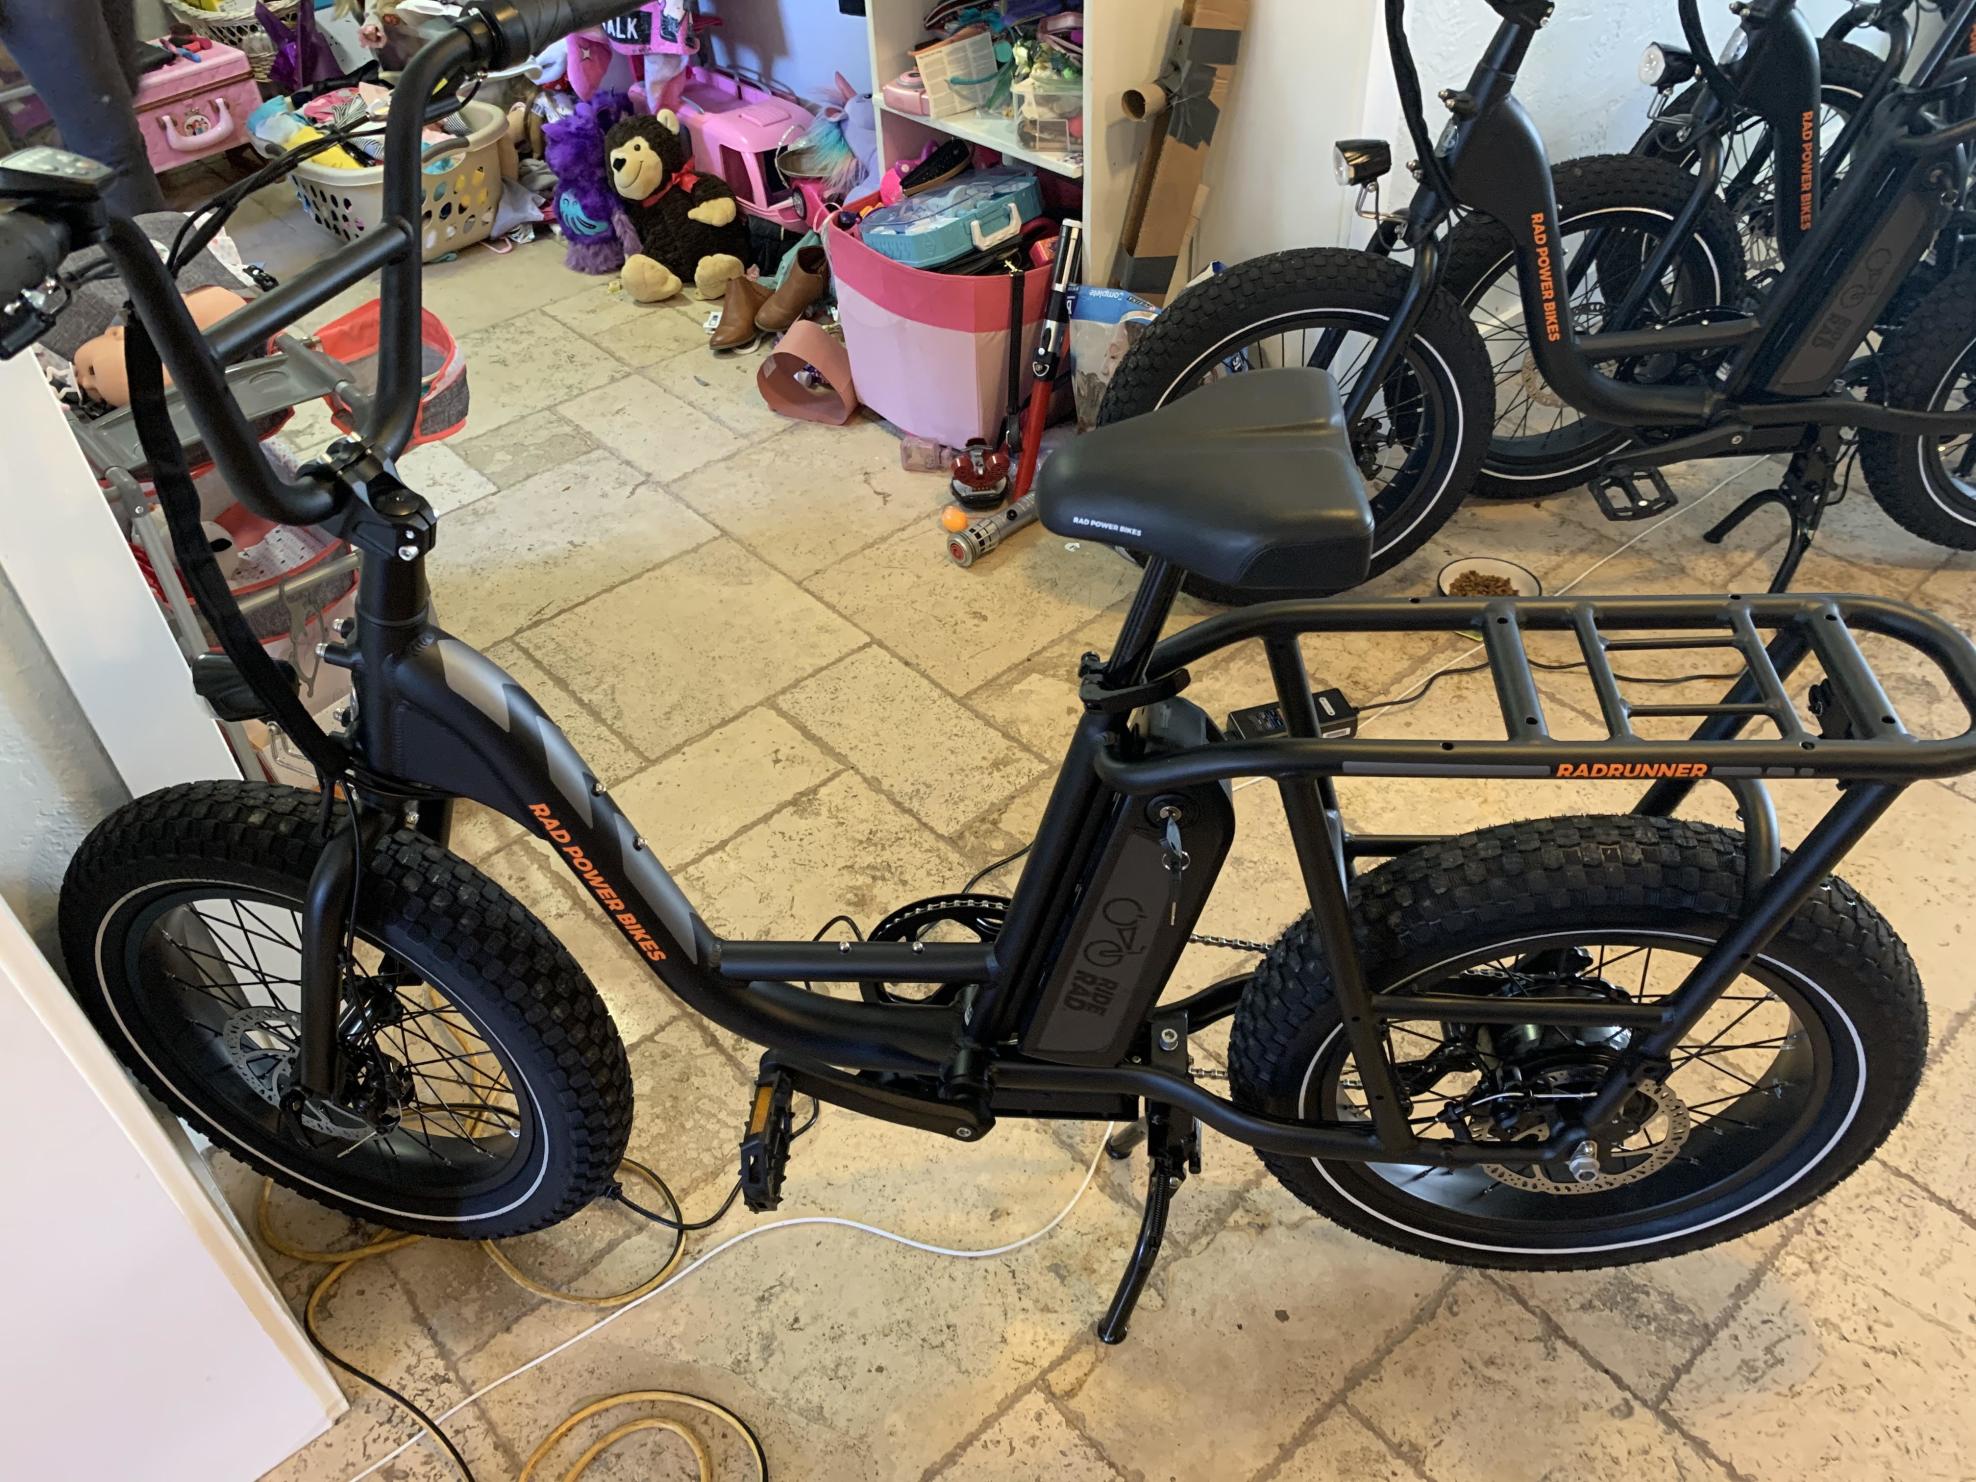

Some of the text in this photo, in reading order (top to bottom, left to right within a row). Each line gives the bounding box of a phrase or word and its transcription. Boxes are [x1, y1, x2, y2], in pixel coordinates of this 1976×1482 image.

[1800, 111, 1813, 230] RAD POWER BIKES
[1531, 212, 1560, 342] RAD POWER BIKES
[1073, 517, 1142, 536] RAD POWER BIKES
[1556, 763, 1708, 777] RADRUNNER
[528, 803, 667, 961] RAD POWER BIKES
[1064, 970, 1097, 1011] RAD
[1087, 977, 1119, 1016] RIDE
